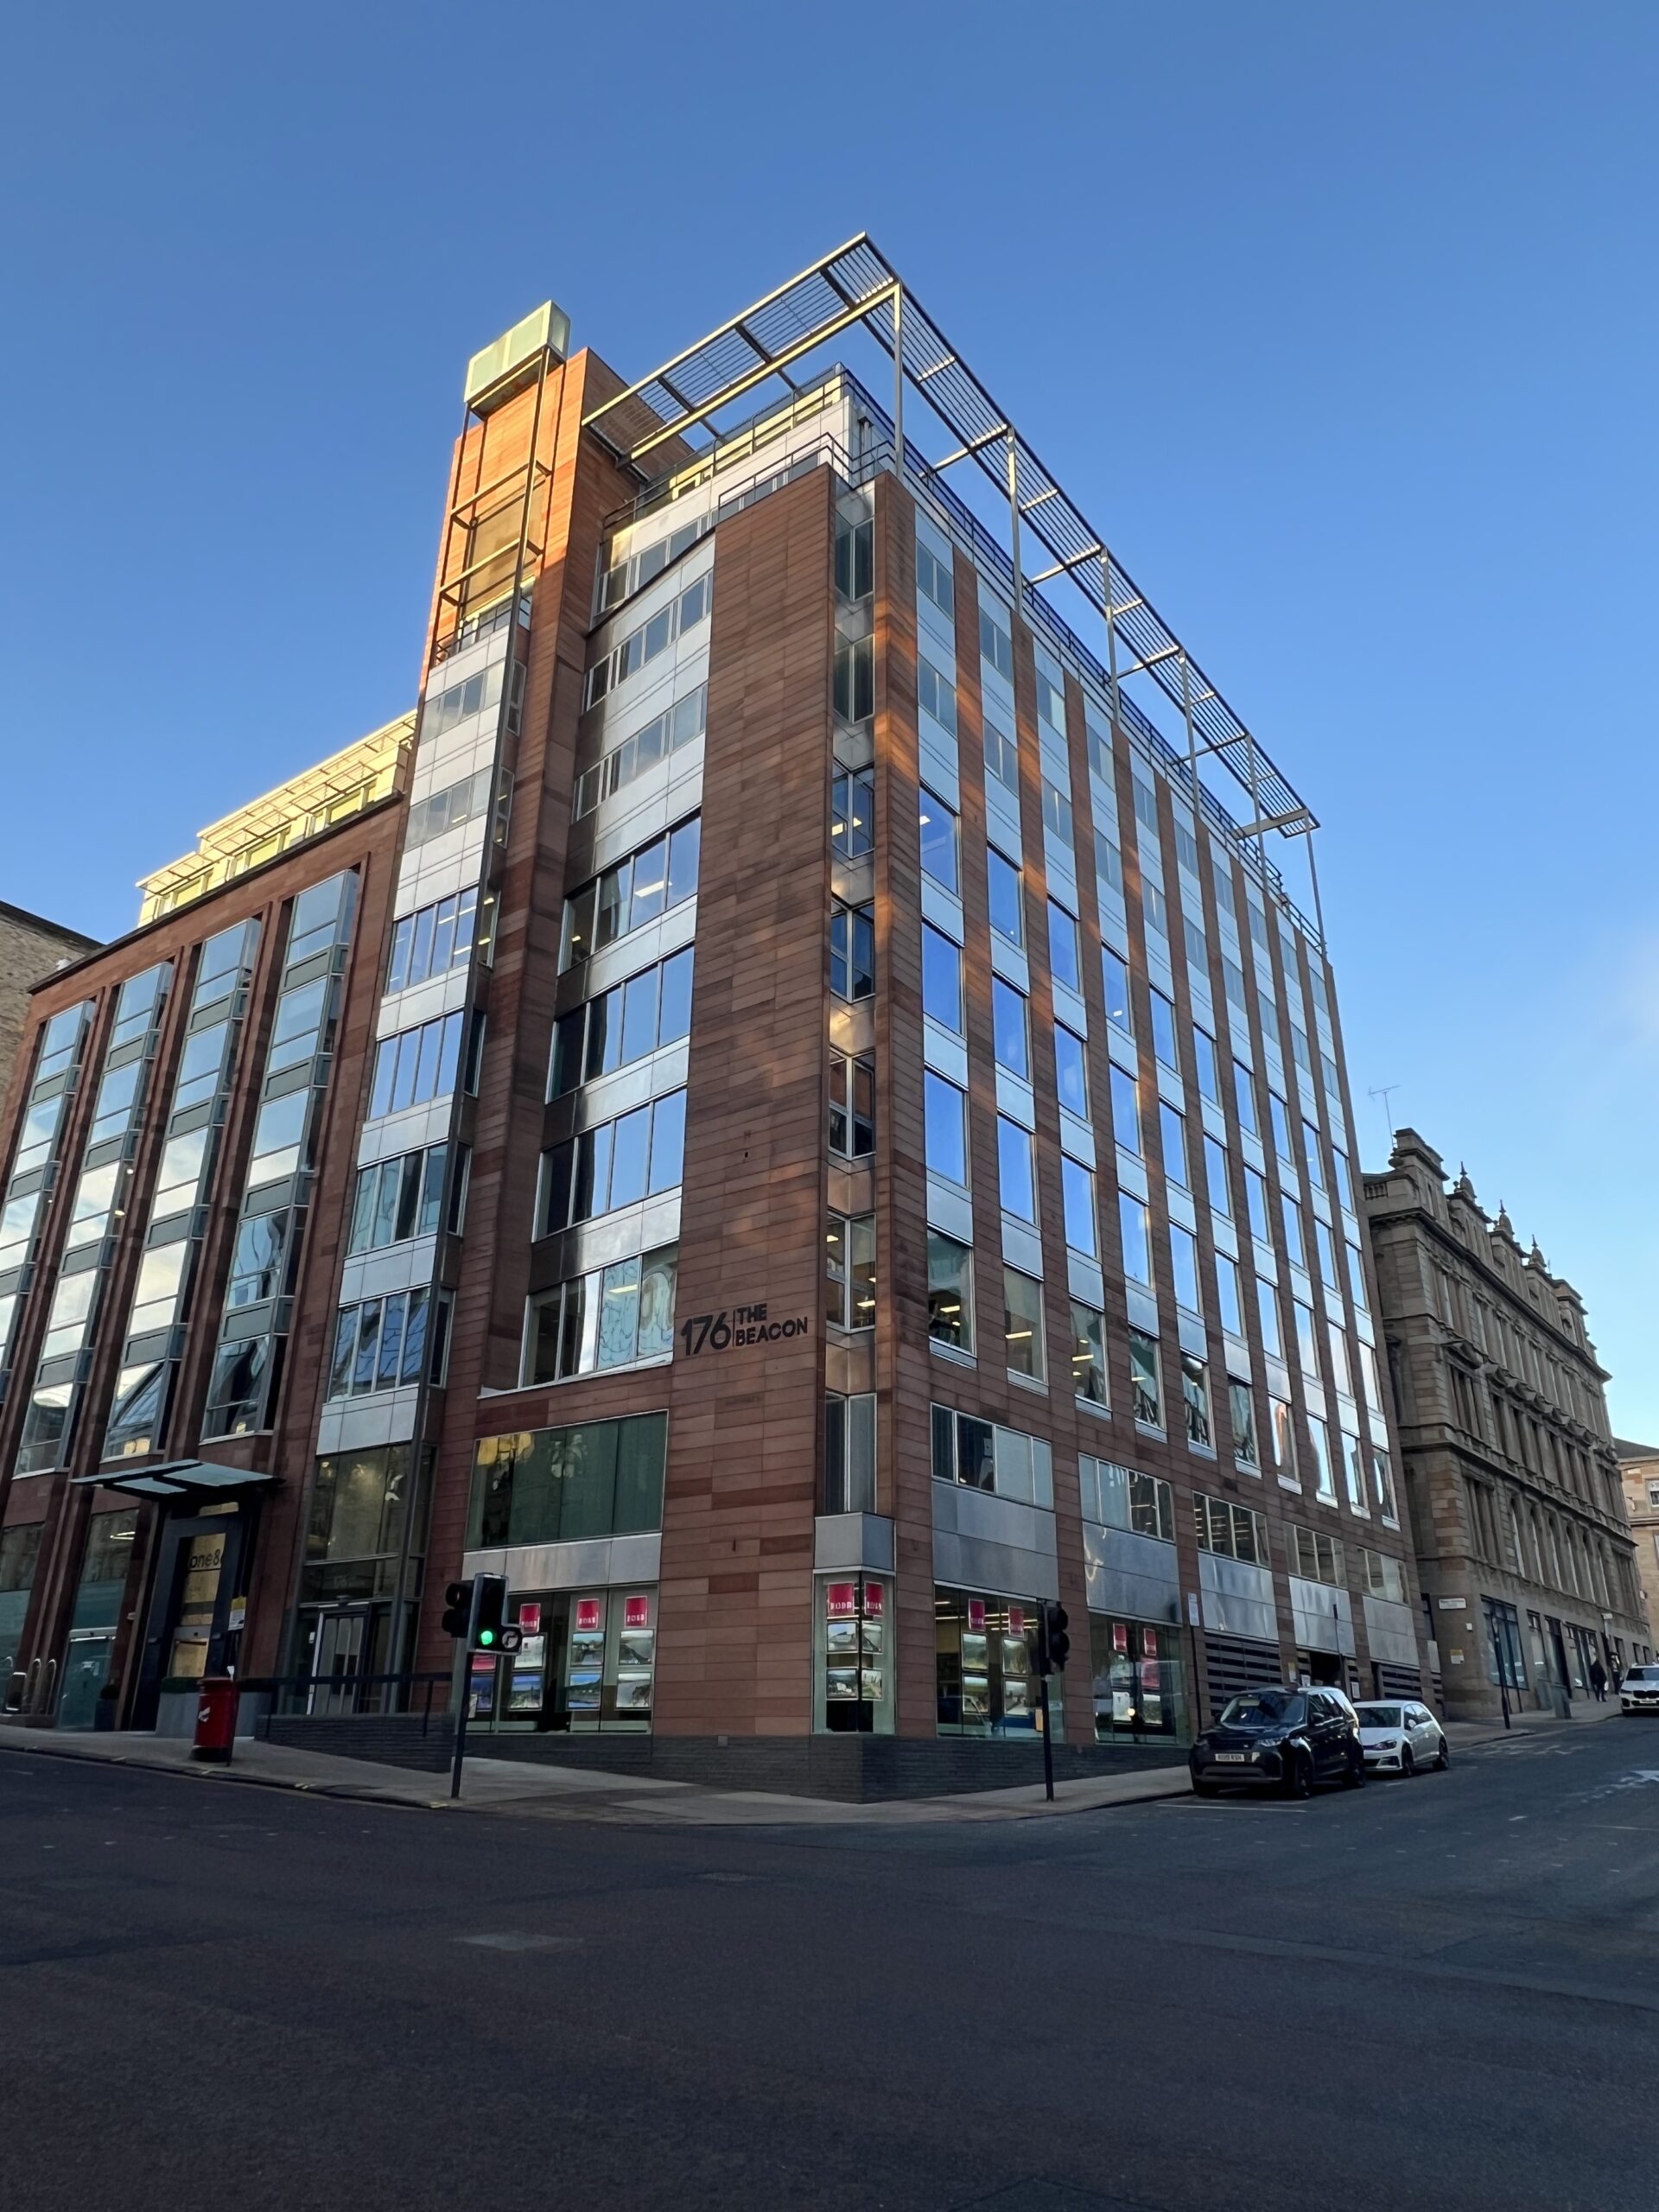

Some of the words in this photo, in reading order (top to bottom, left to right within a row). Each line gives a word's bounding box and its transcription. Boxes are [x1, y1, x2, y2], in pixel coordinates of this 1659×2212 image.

[736, 1303, 767, 1325] THE
[681, 1312, 732, 1356] 176
[735, 1317, 808, 1346] BEACON
[190, 1548, 222, 1568] one8
